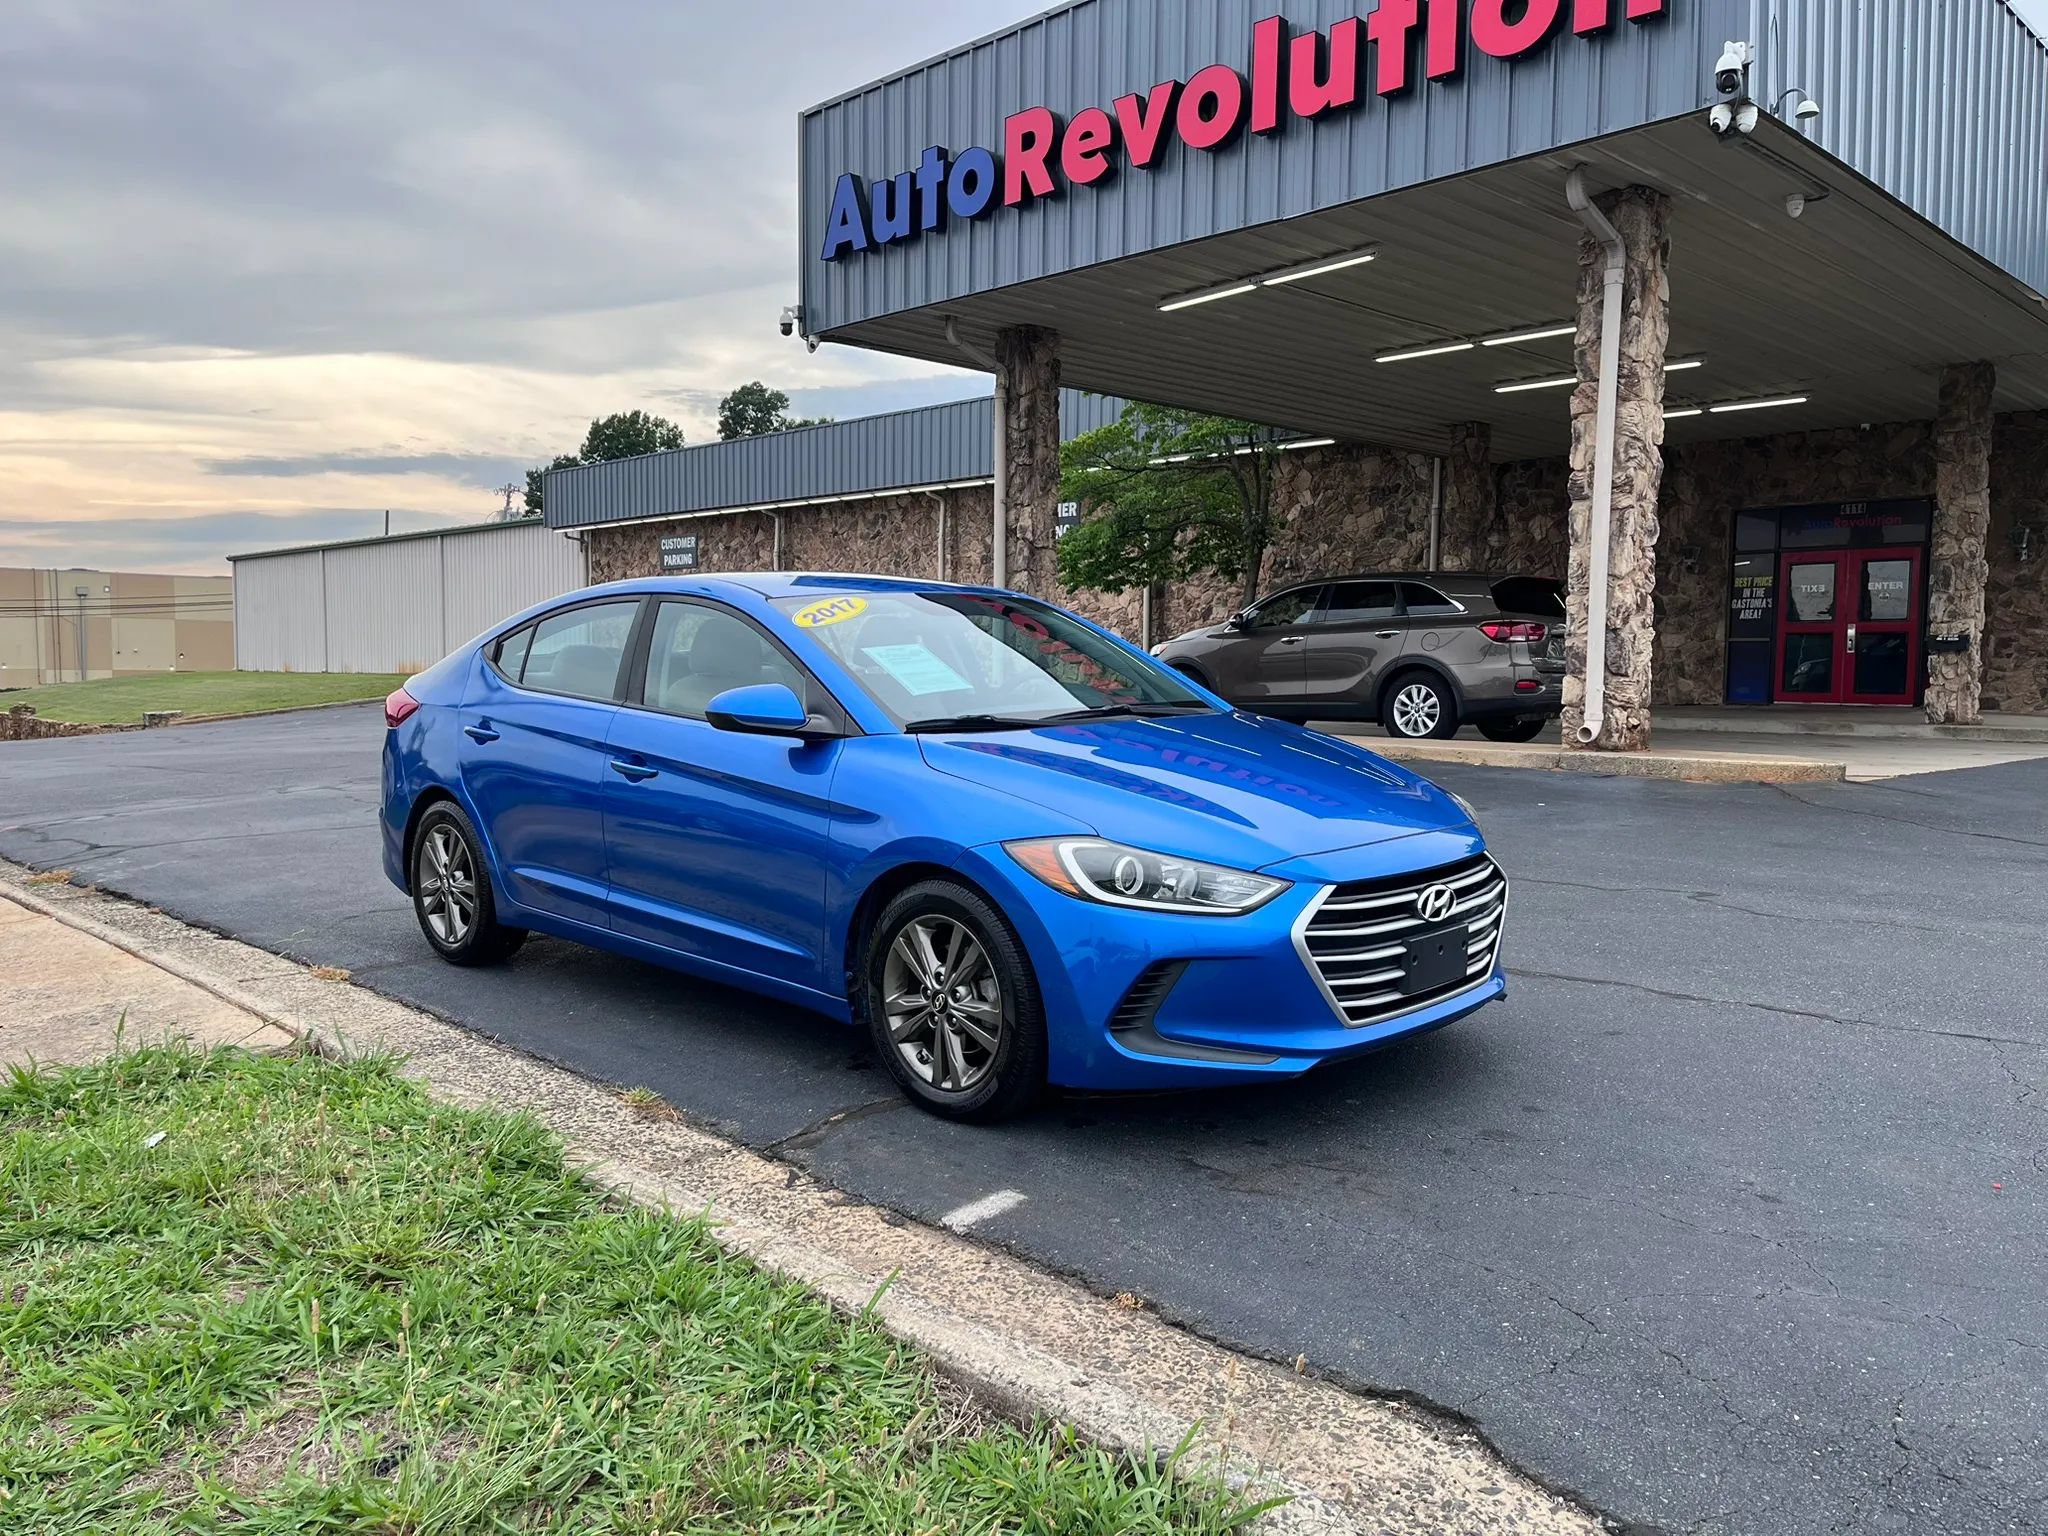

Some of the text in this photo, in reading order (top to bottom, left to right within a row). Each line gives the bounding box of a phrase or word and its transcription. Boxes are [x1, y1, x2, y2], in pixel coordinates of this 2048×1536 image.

[661, 536, 696, 550] CUSTOMER
[664, 553, 692, 567] PARKING
[1734, 576, 1774, 588] BEST PRICE
[1868, 581, 1903, 590] ENTER
[1752, 588, 1766, 597] THE
[1731, 598, 1773, 609] GASTONIA'S
[802, 598, 857, 625] 2017
[1739, 609, 1762, 619] AREA!
